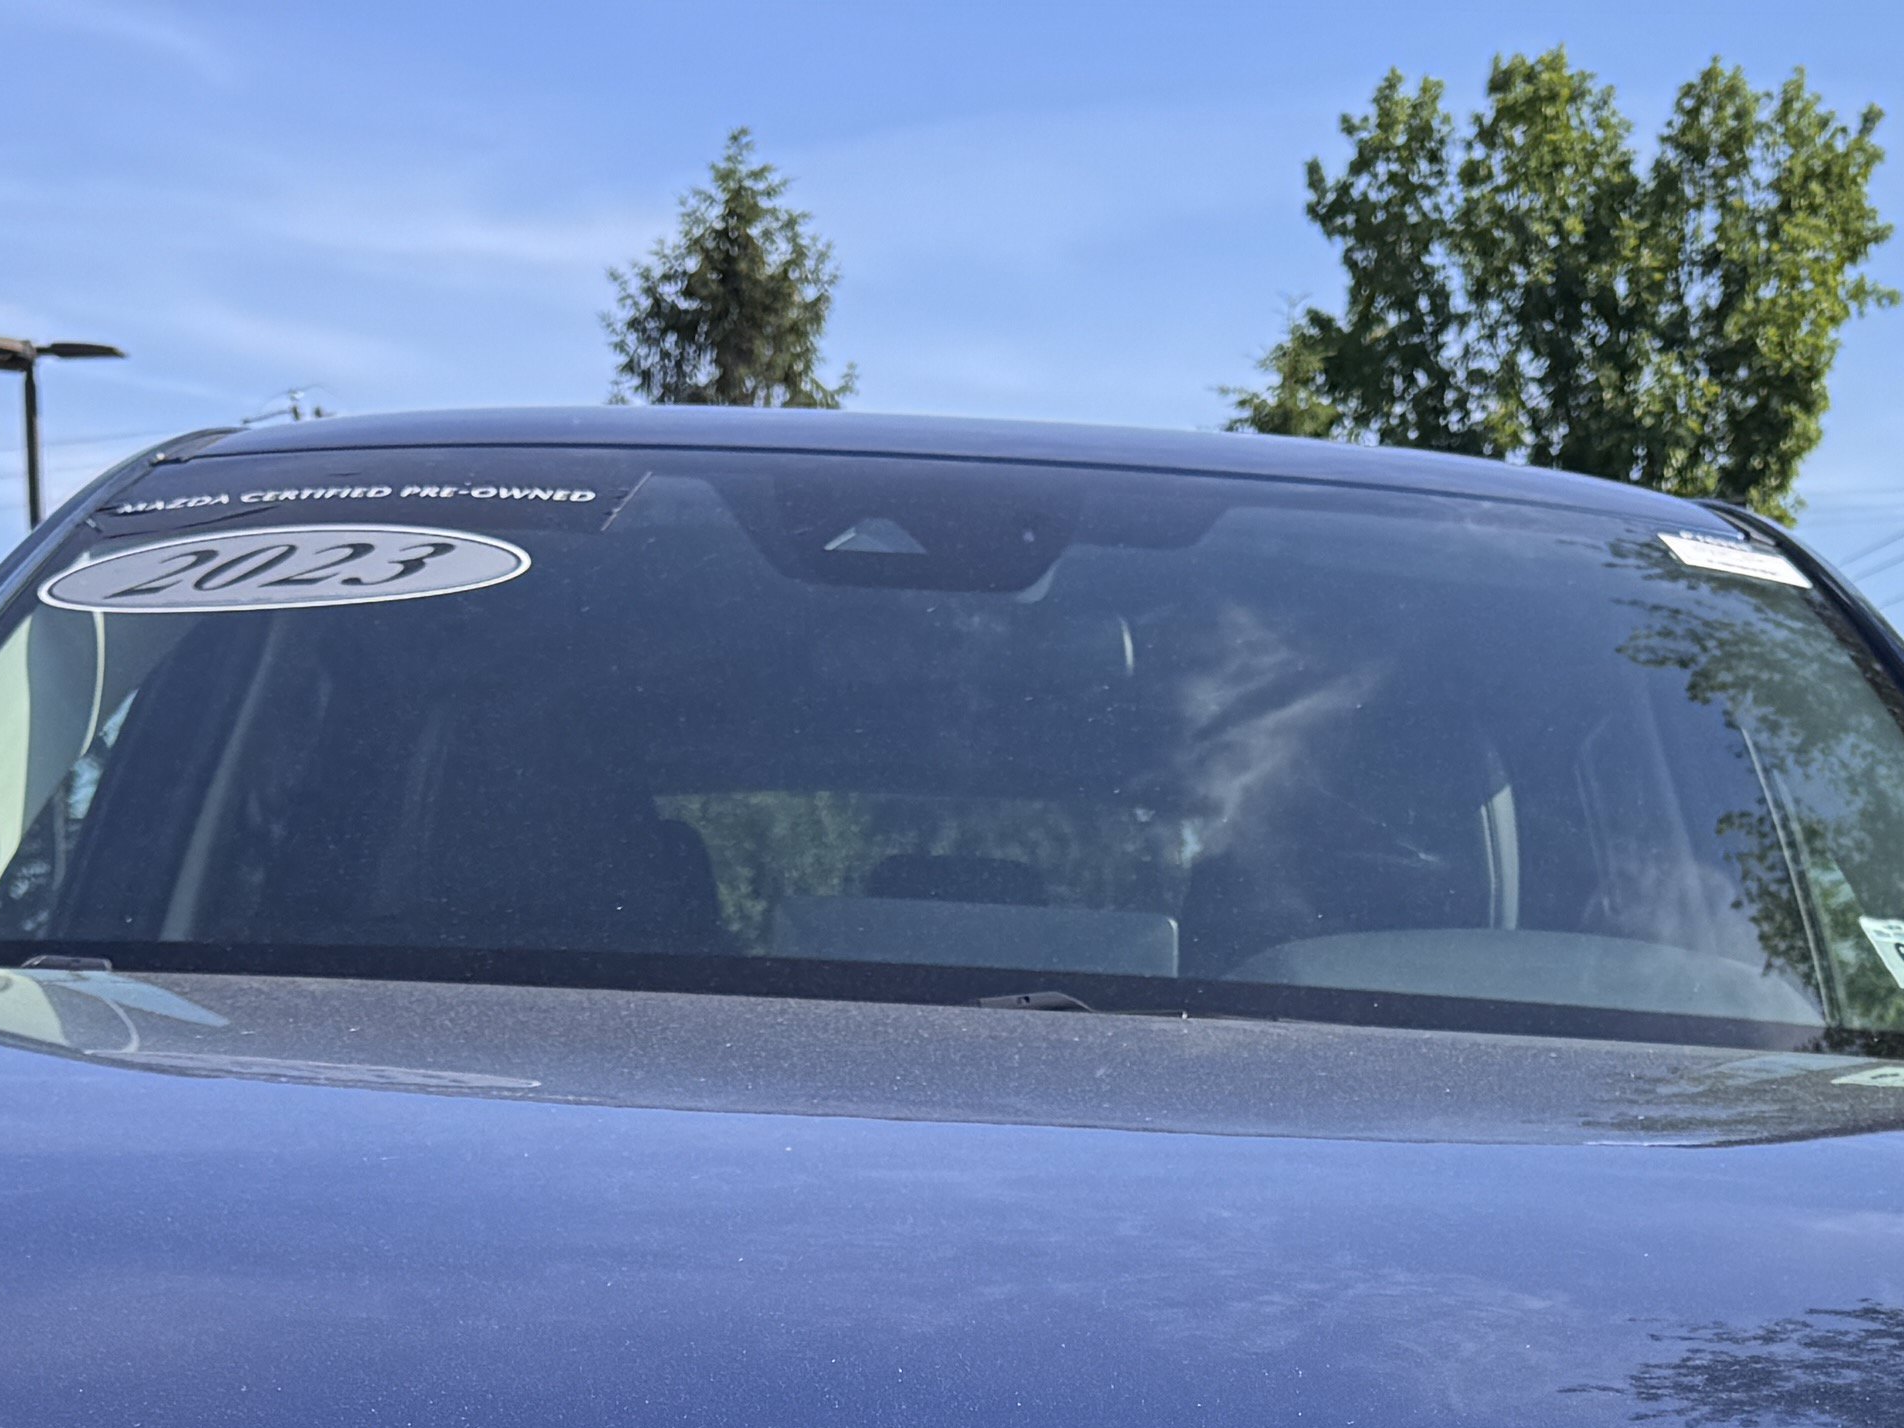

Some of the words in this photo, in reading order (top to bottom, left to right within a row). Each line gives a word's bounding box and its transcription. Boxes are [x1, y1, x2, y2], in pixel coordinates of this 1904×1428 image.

[115, 494, 230, 515] MAZDA
[240, 485, 393, 503] CERTIFIED
[399, 485, 597, 503] PRE-OWNED
[103, 542, 457, 600] 2023
